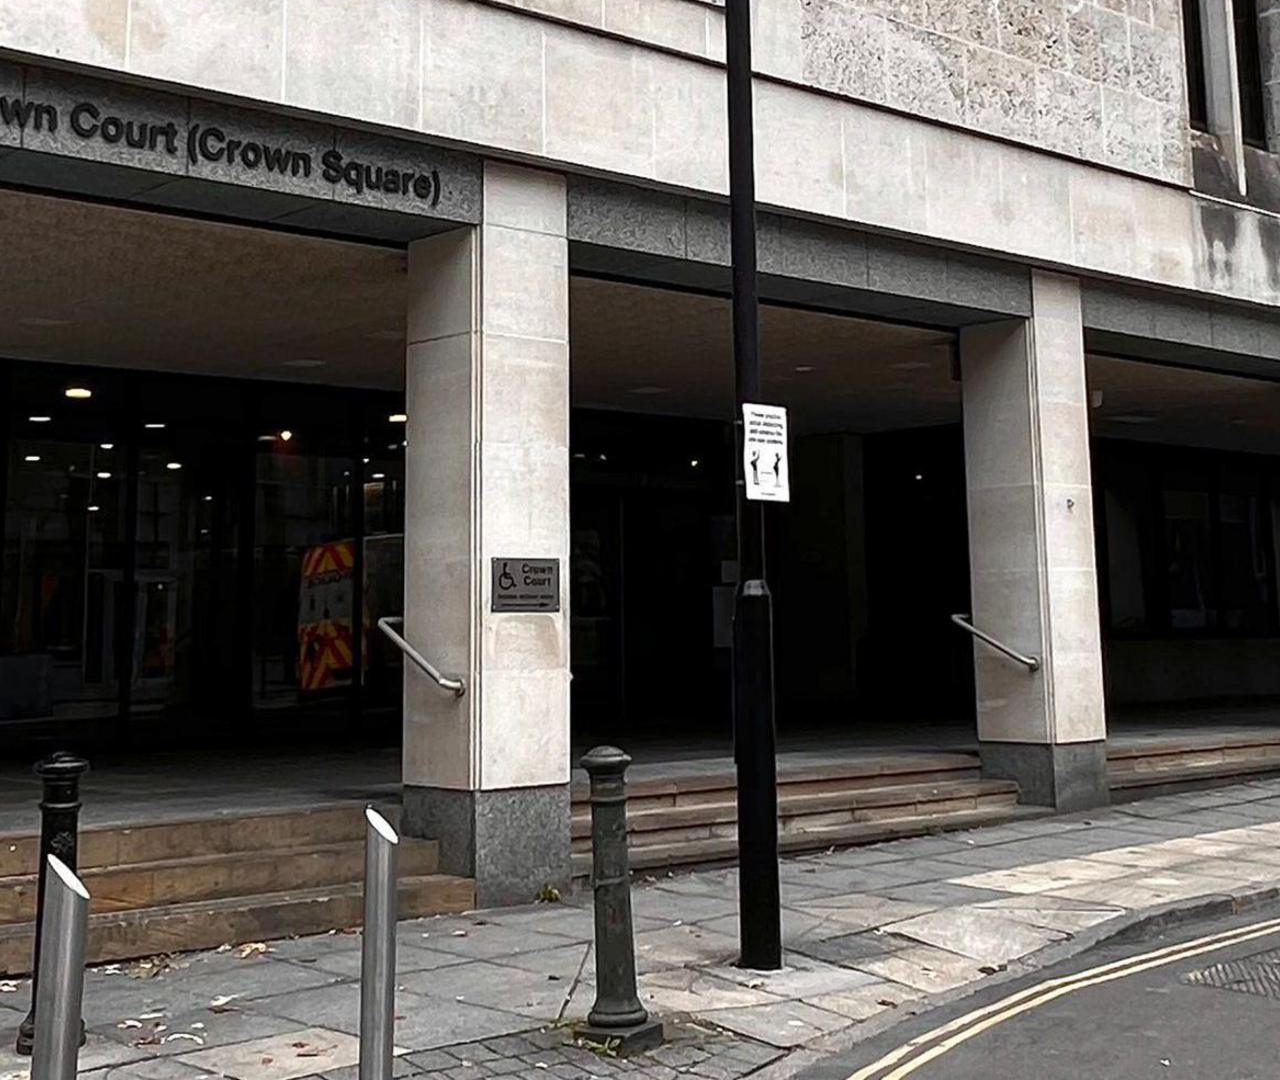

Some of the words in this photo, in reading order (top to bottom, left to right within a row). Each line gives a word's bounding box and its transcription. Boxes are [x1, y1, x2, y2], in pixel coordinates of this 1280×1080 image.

[70, 102, 178, 154] Court
[187, 123, 311, 178] (Crown
[322, 149, 441, 207] Square)
[522, 563, 553, 574] Crown
[524, 576, 551, 586] Court
